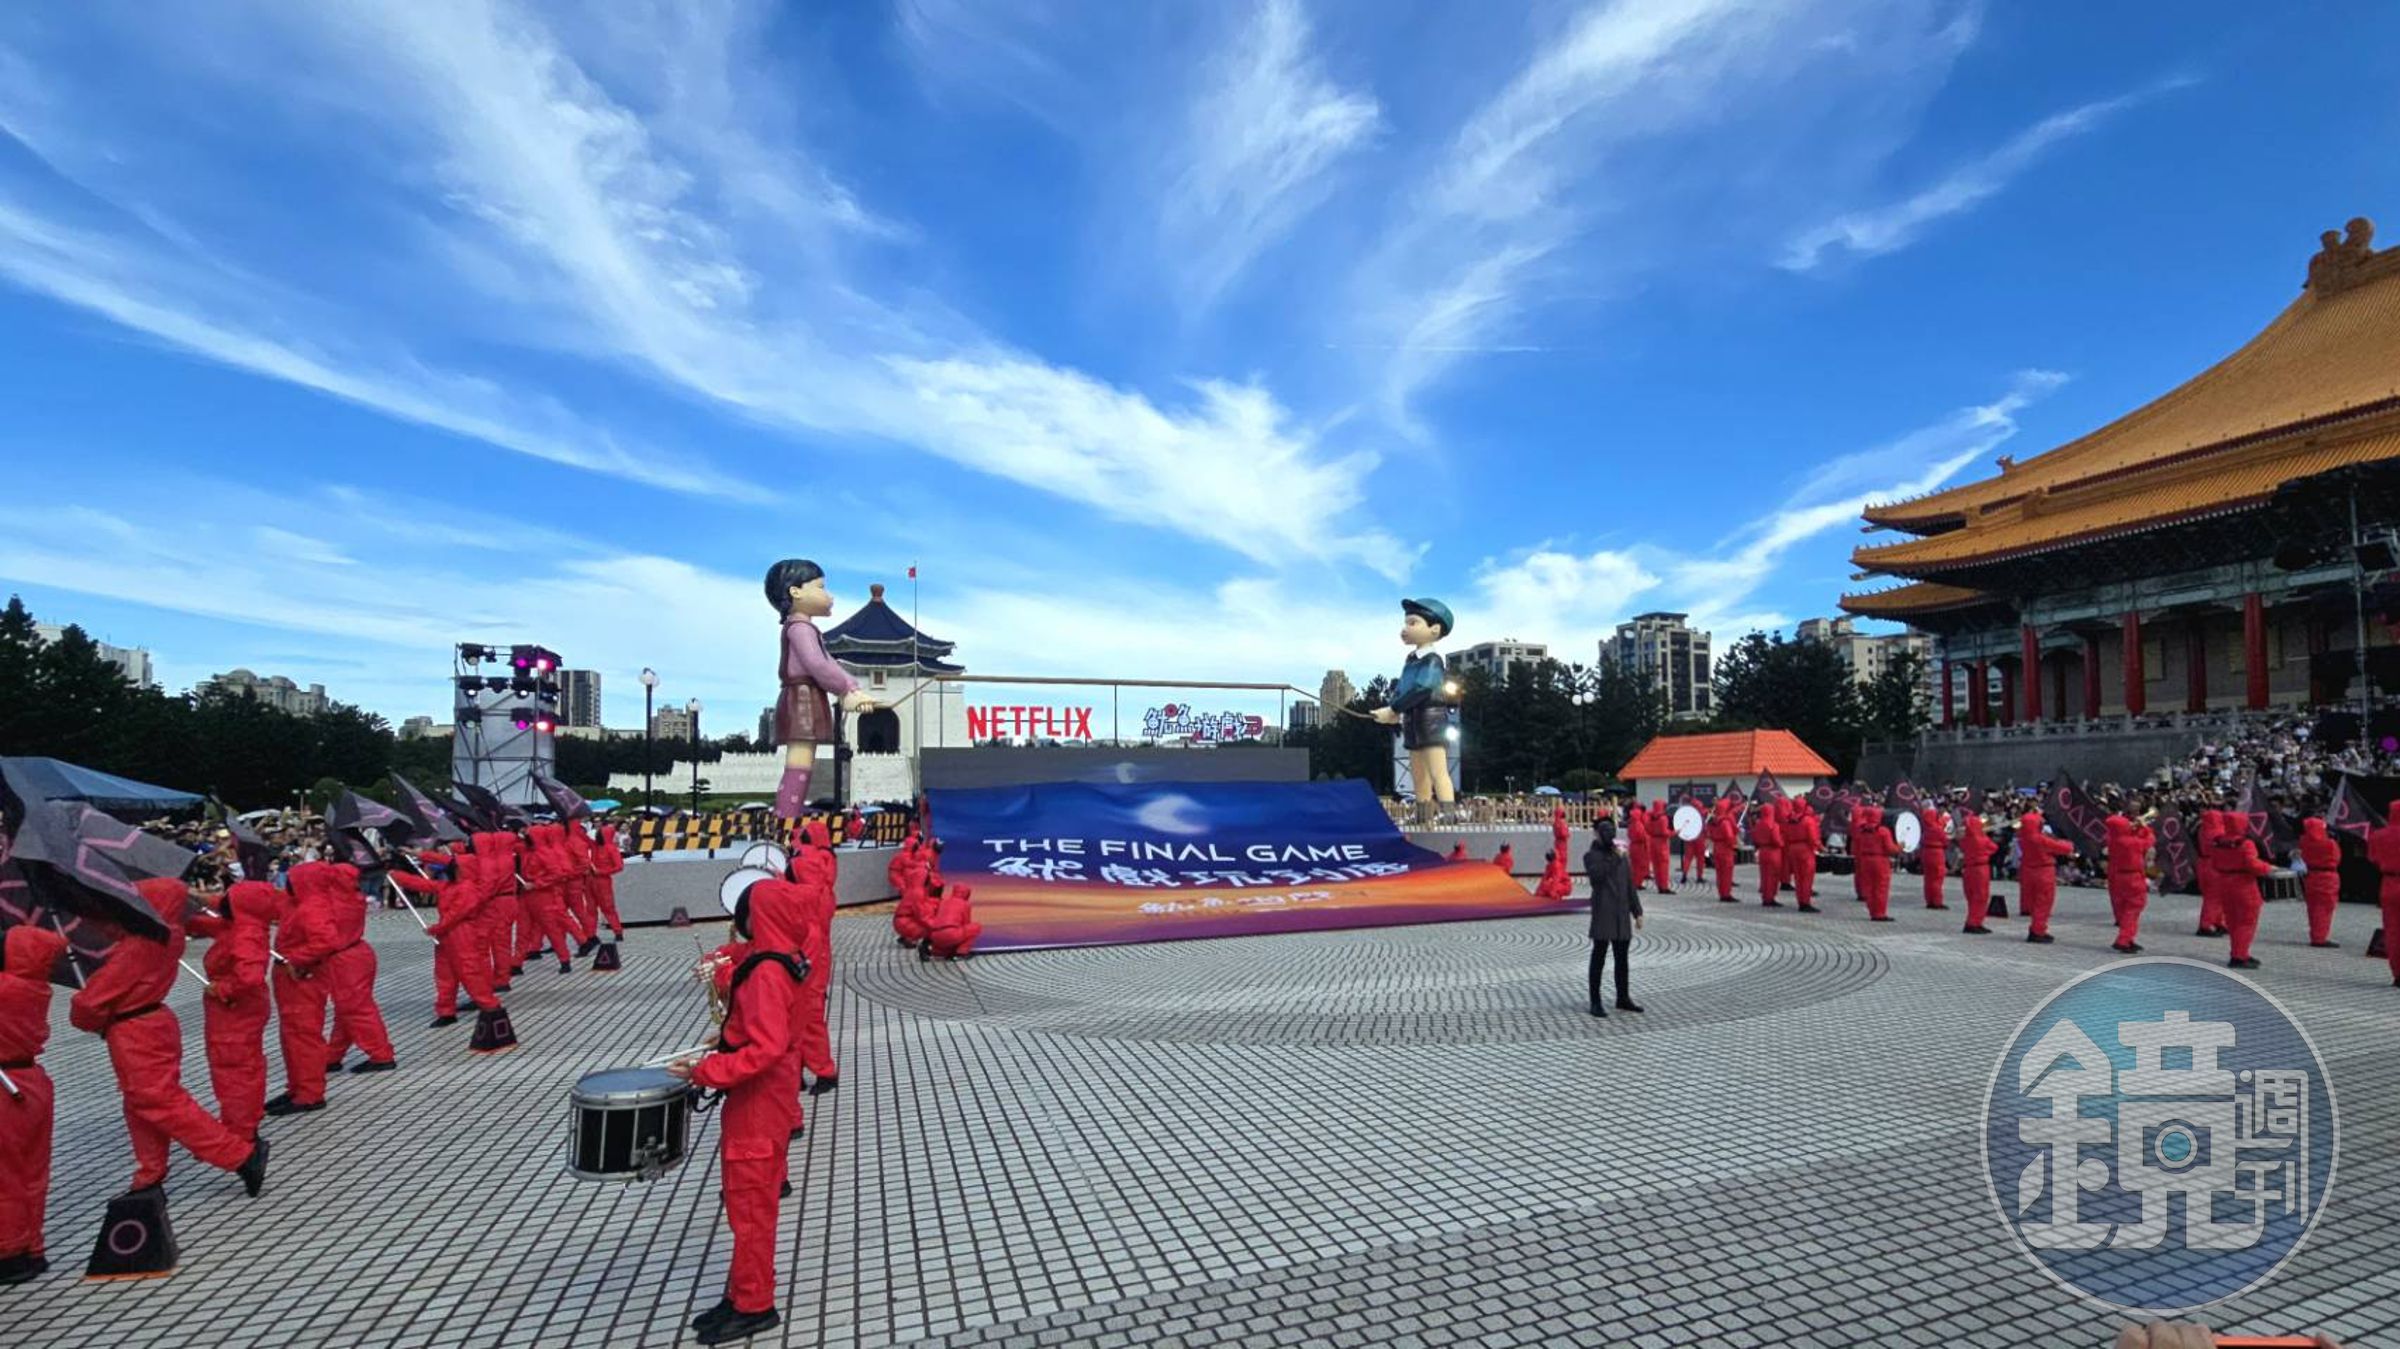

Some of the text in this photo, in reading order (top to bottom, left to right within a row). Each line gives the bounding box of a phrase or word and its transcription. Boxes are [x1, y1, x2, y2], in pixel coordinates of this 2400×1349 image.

[966, 705, 1092, 739] NETFLIX
[983, 839, 1370, 862] THE FINAL GAME
